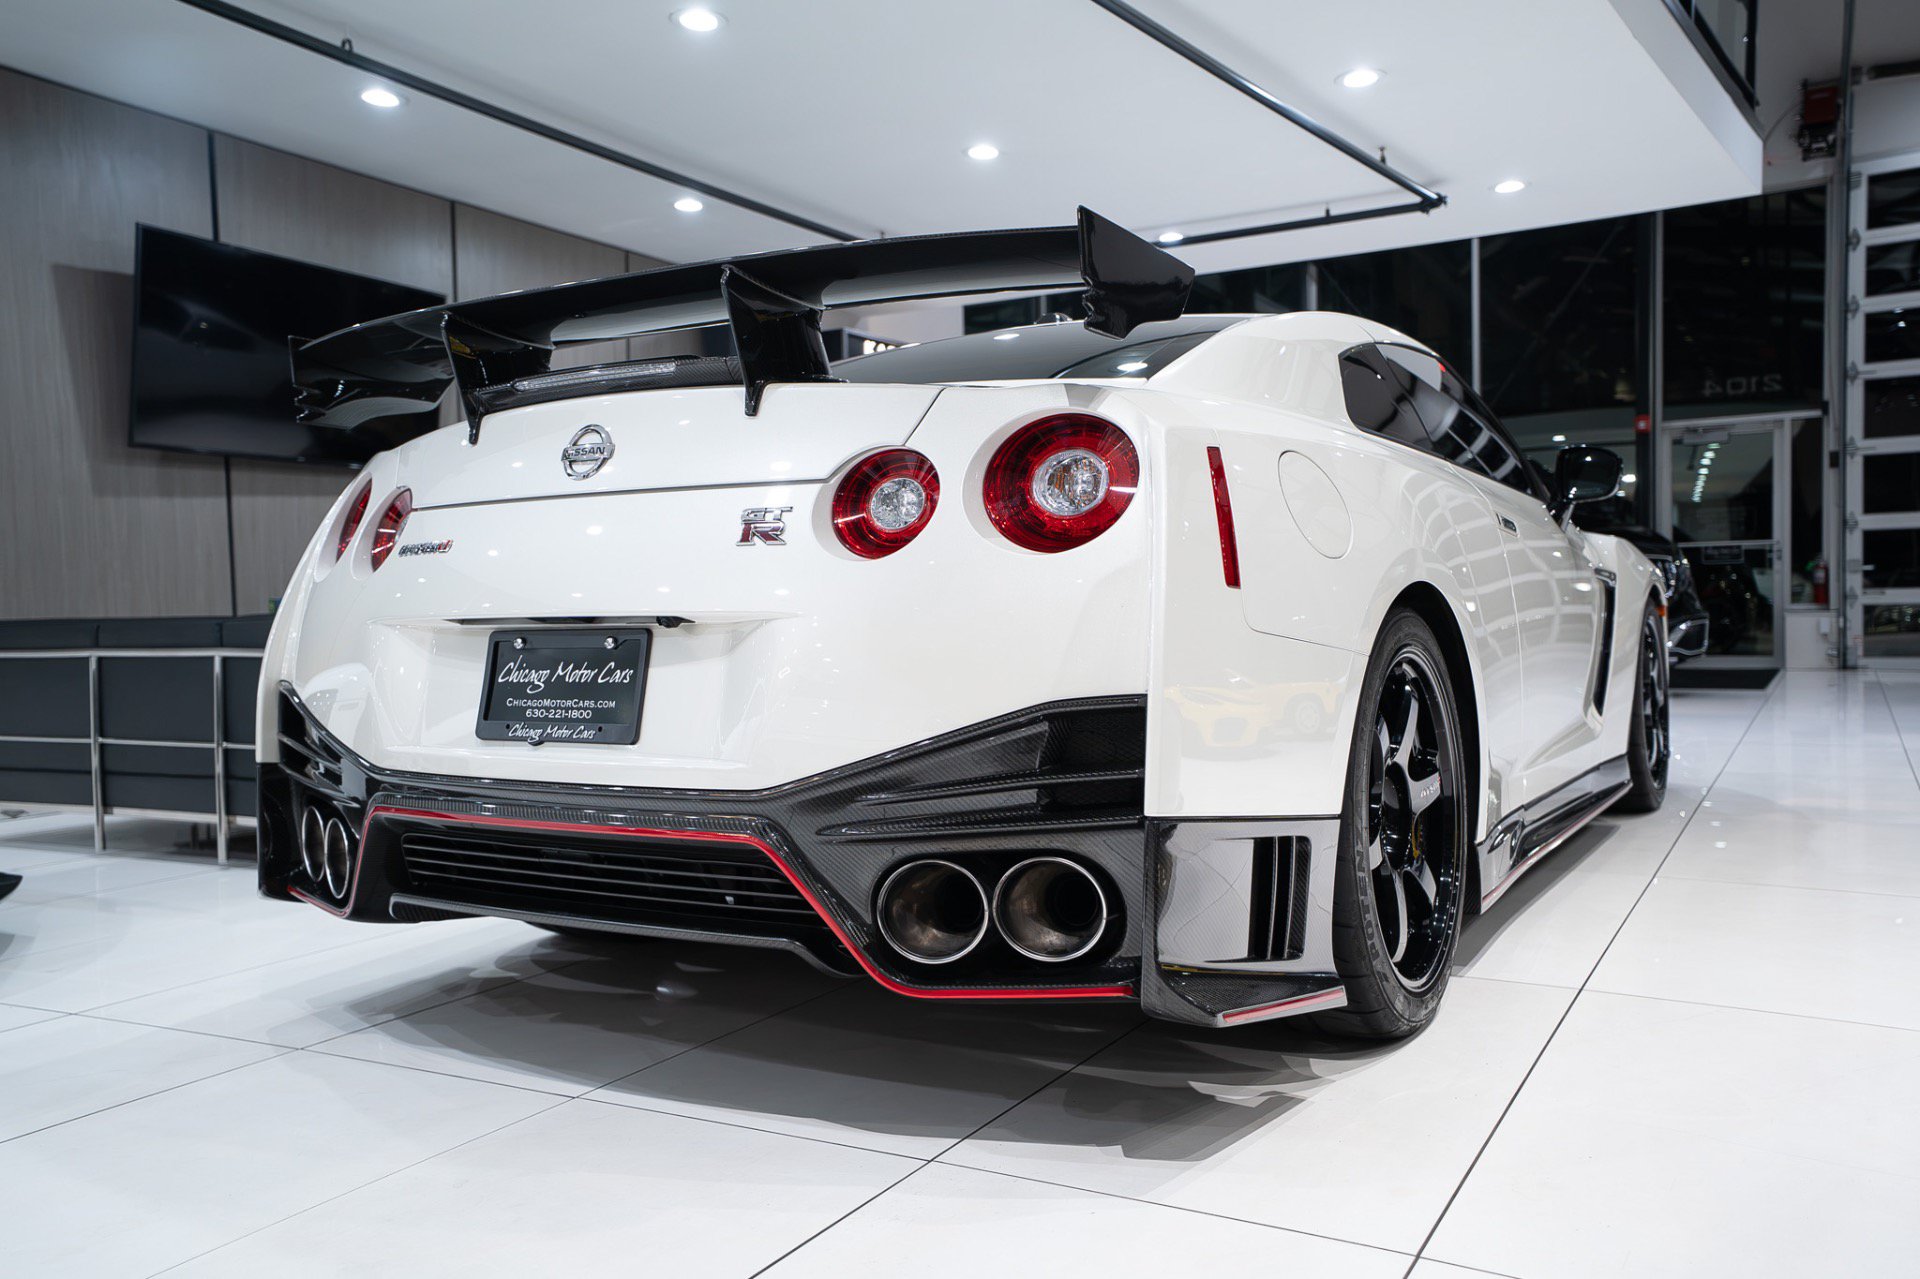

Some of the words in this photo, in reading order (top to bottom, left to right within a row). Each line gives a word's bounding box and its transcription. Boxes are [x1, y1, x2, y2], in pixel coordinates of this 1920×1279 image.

[498, 654, 550, 694] Chicago
[551, 661, 598, 683] Motor
[598, 662, 634, 683] Cars
[525, 709, 593, 719] 630-221-1800
[508, 722, 542, 743] Chicago
[543, 724, 573, 739] Motor
[573, 726, 596, 739] Cars
